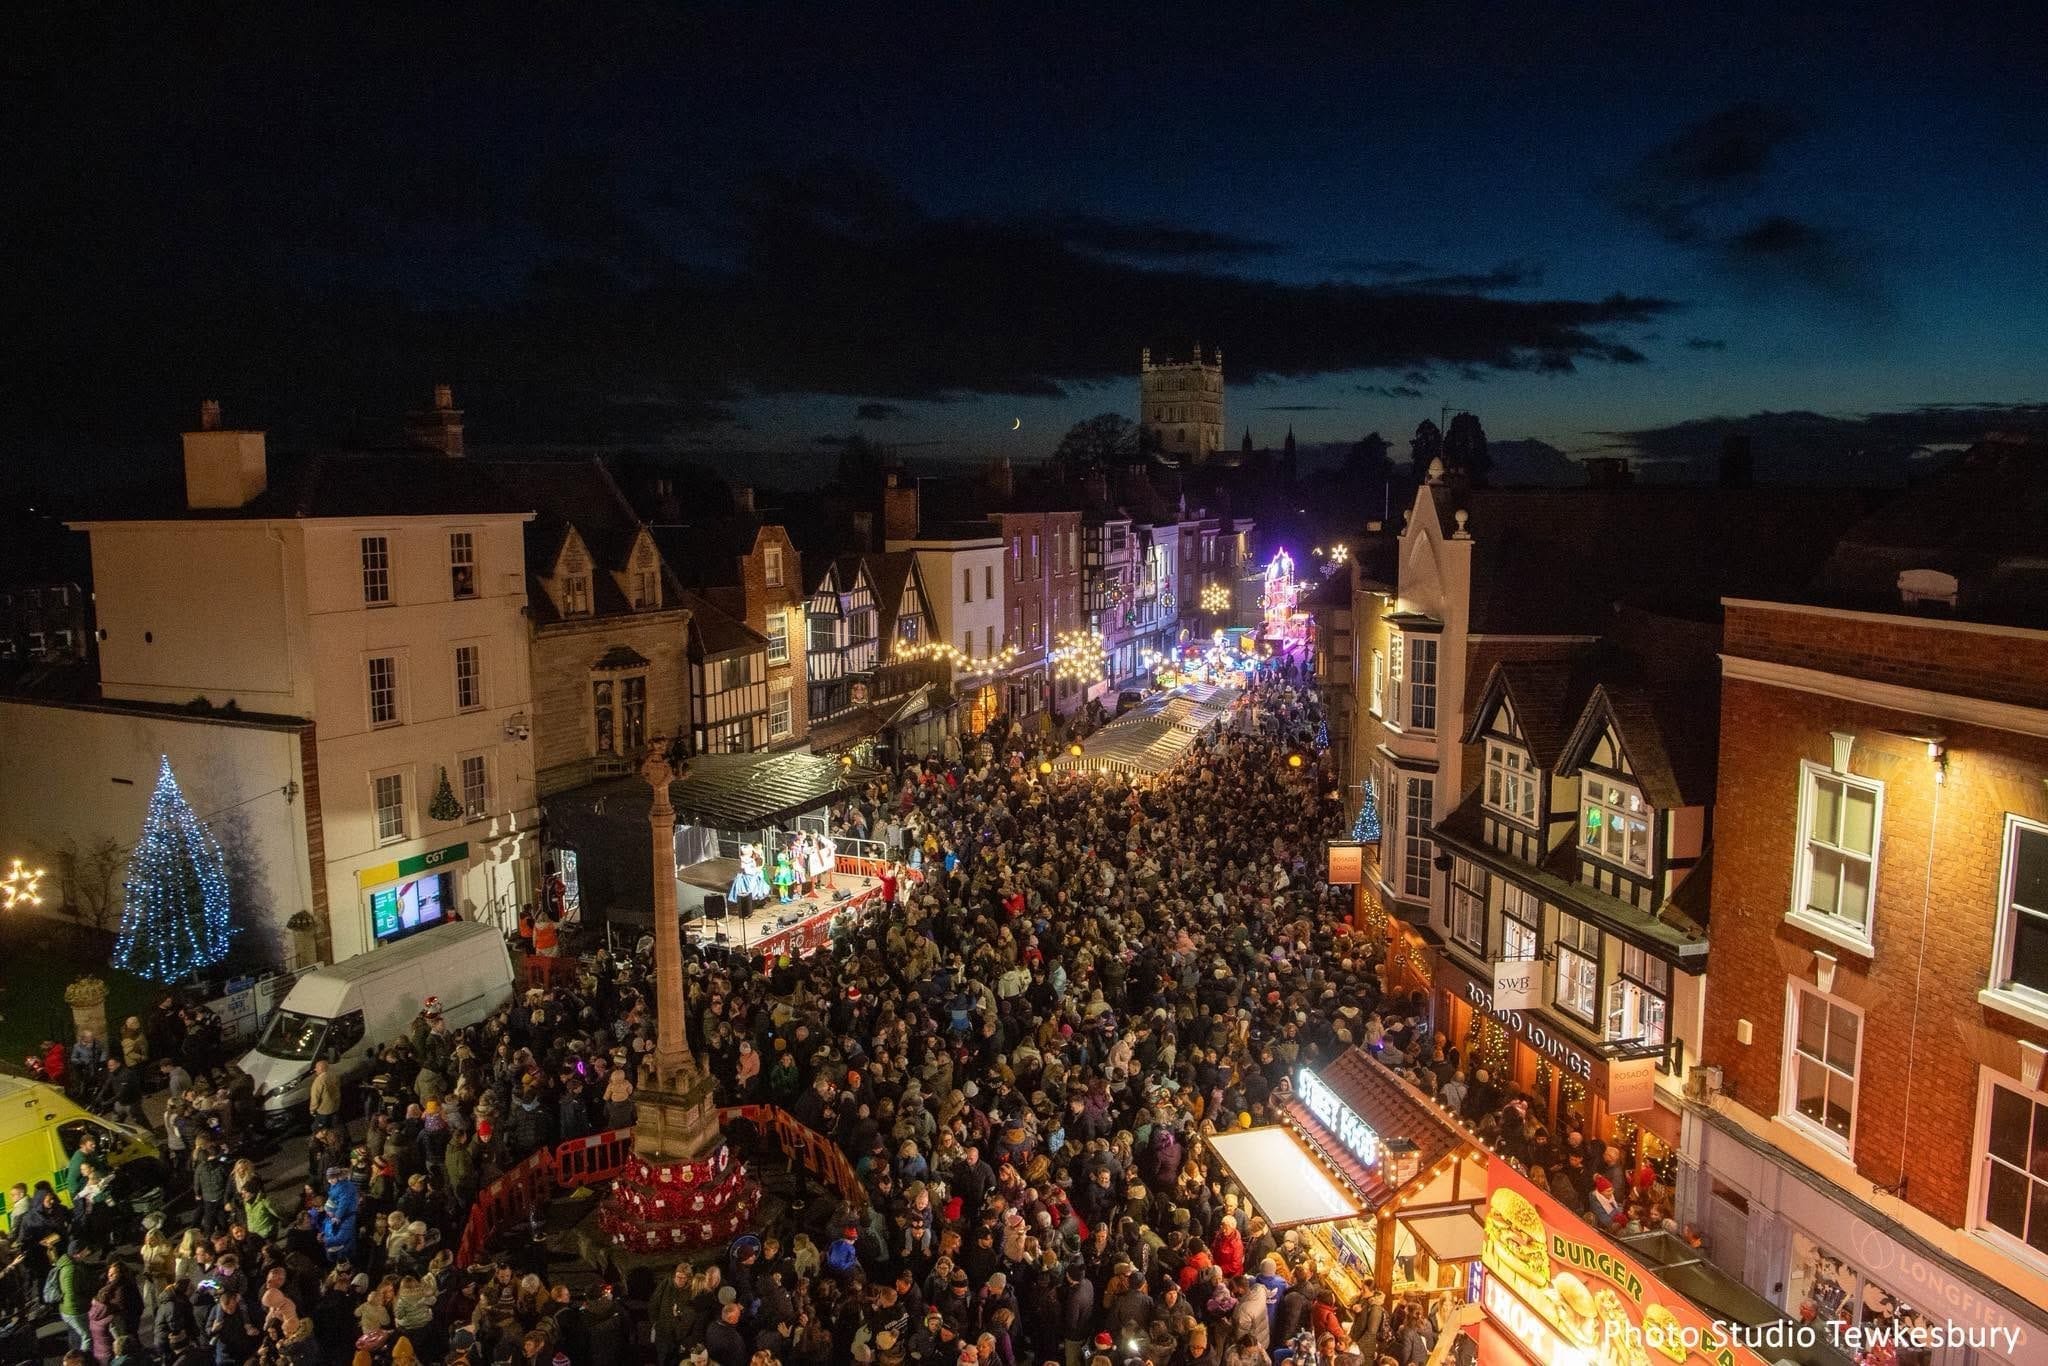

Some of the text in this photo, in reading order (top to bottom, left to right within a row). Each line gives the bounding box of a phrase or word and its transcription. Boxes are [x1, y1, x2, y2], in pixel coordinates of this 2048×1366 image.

[1498, 976, 1530, 990] SWB
[1526, 1021, 1592, 1082] LOUNGE
[1614, 1068, 1649, 1081] ROSADO
[1614, 1081, 1649, 1094] LOUNGE
[1552, 1234, 1644, 1303] BURGER
